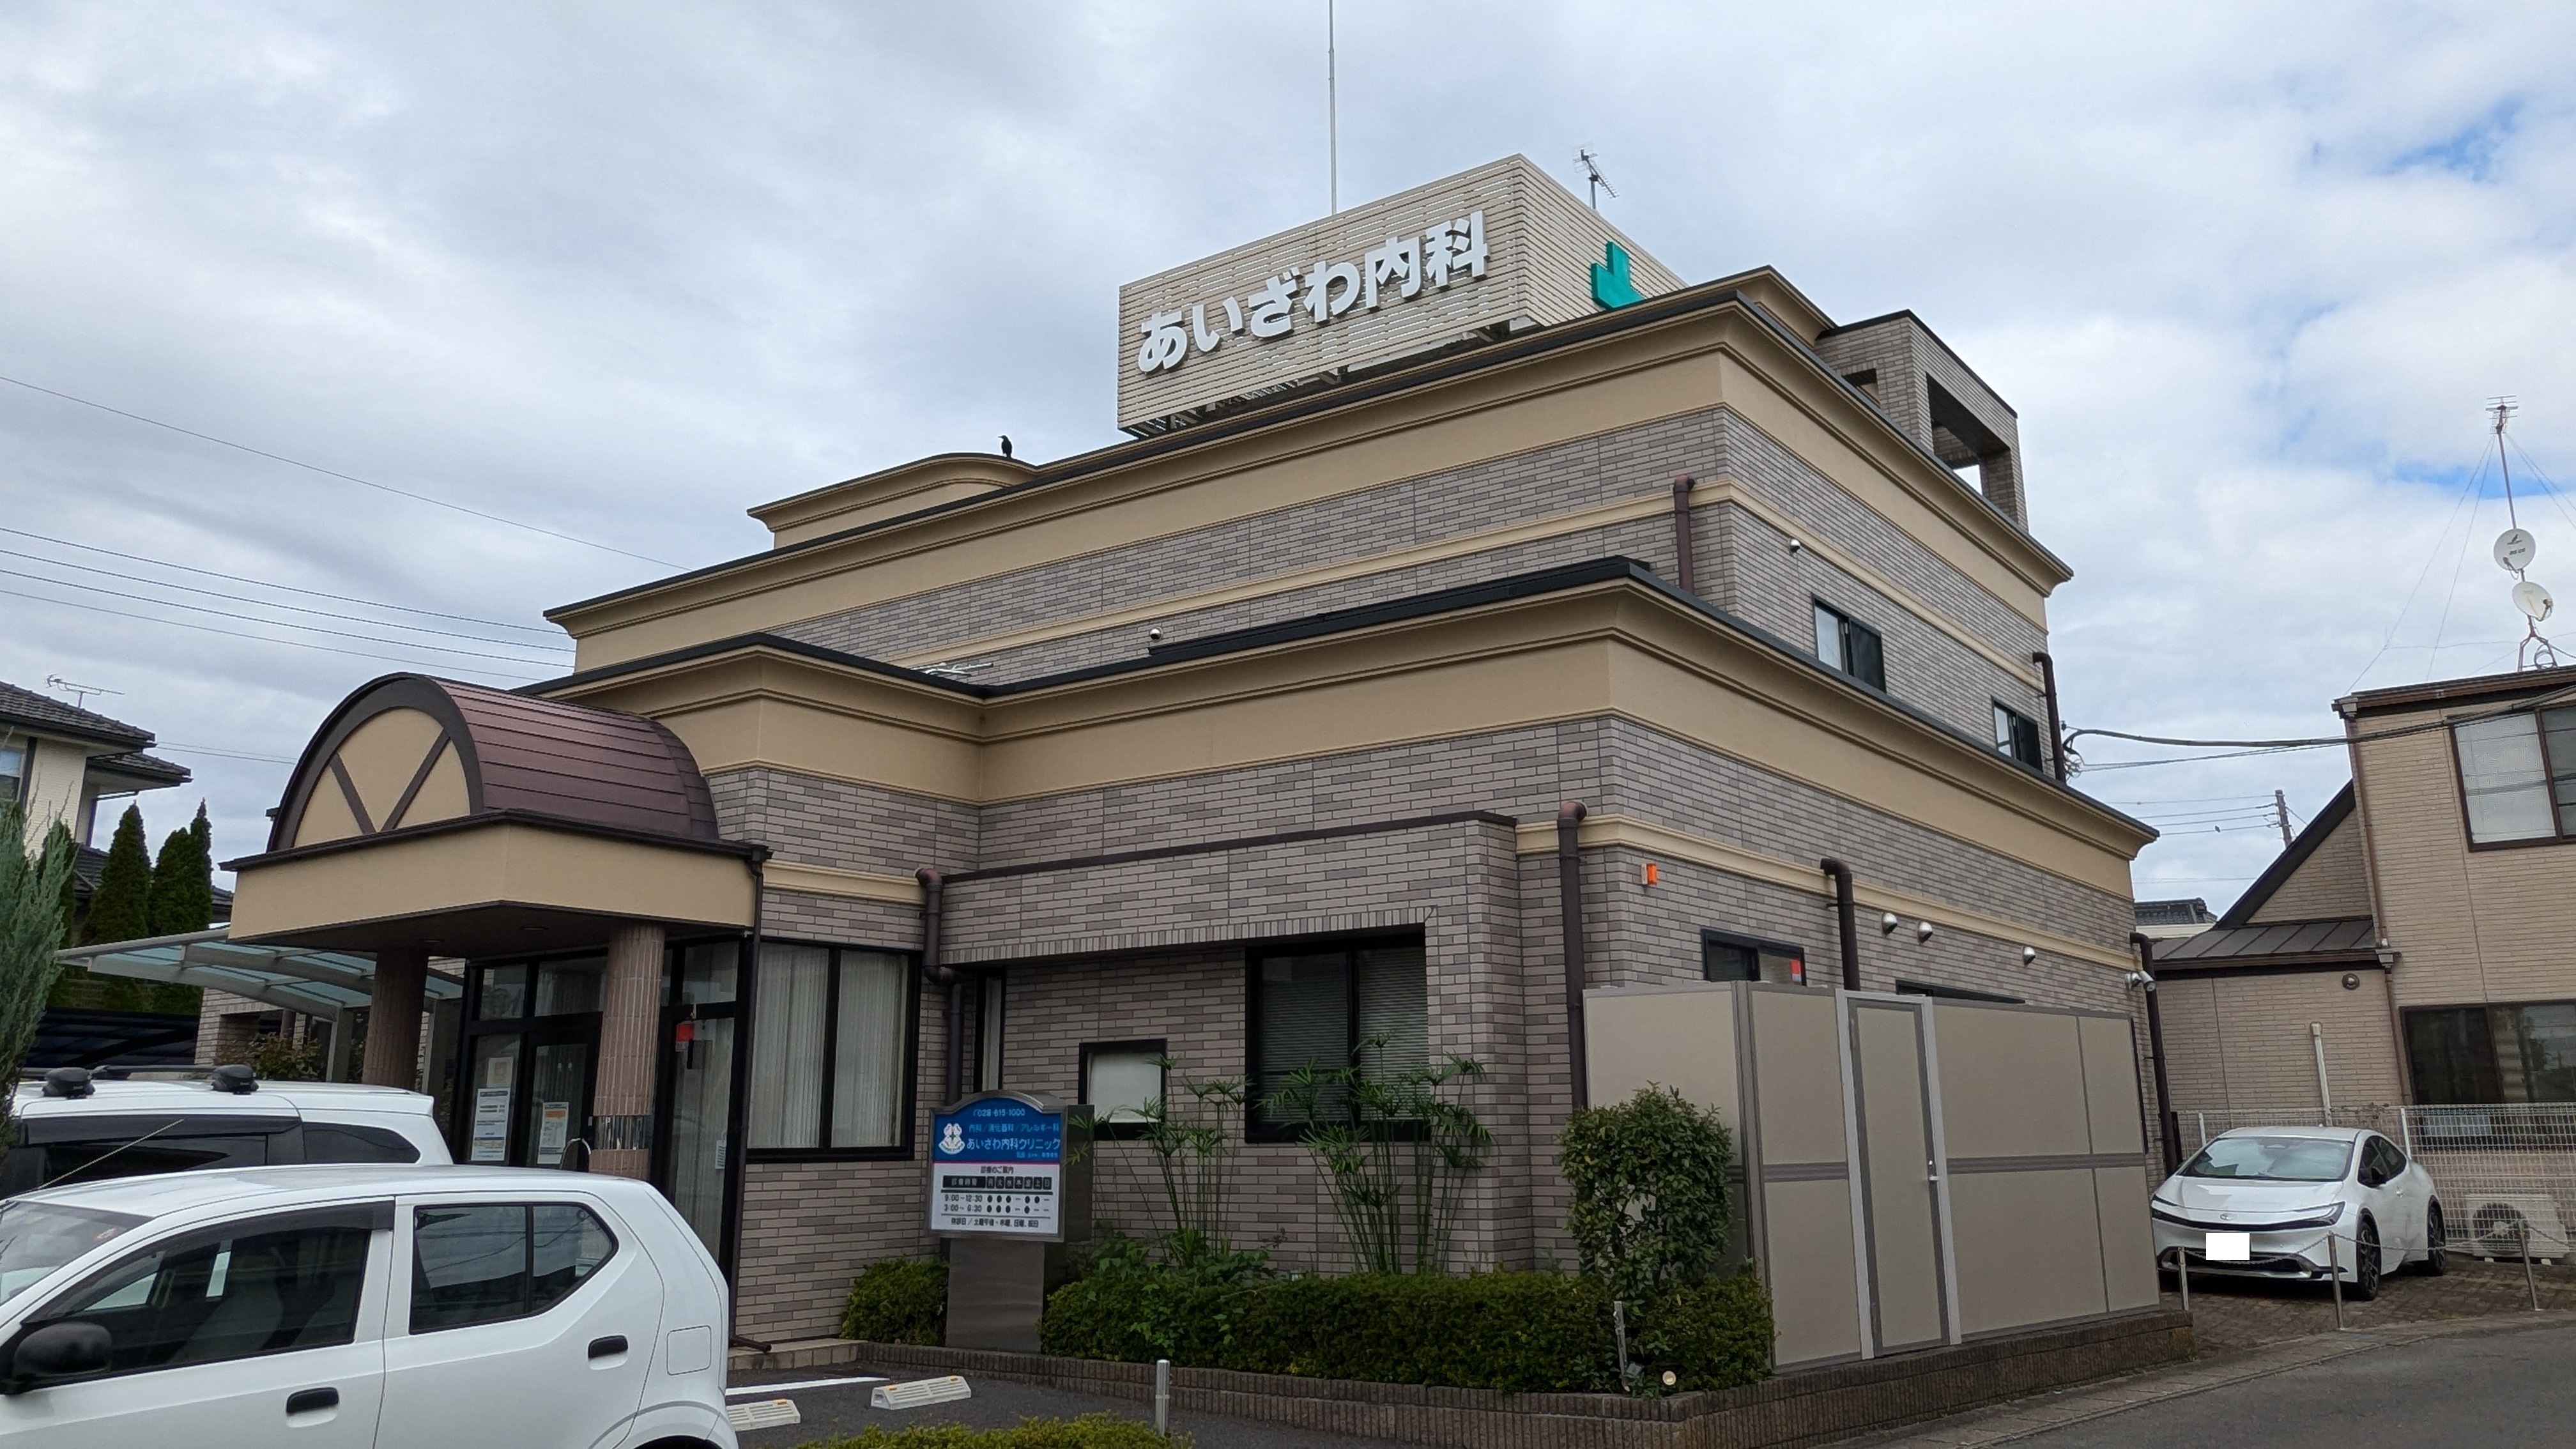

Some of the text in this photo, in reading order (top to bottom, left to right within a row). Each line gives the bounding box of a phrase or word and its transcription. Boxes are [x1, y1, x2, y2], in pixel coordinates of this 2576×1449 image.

[1137, 210, 1491, 374] あいざわ内科
[967, 1137, 1061, 1150] あいざわ内科クリニック
[980, 1166, 1014, 1174] 診療のご案内
